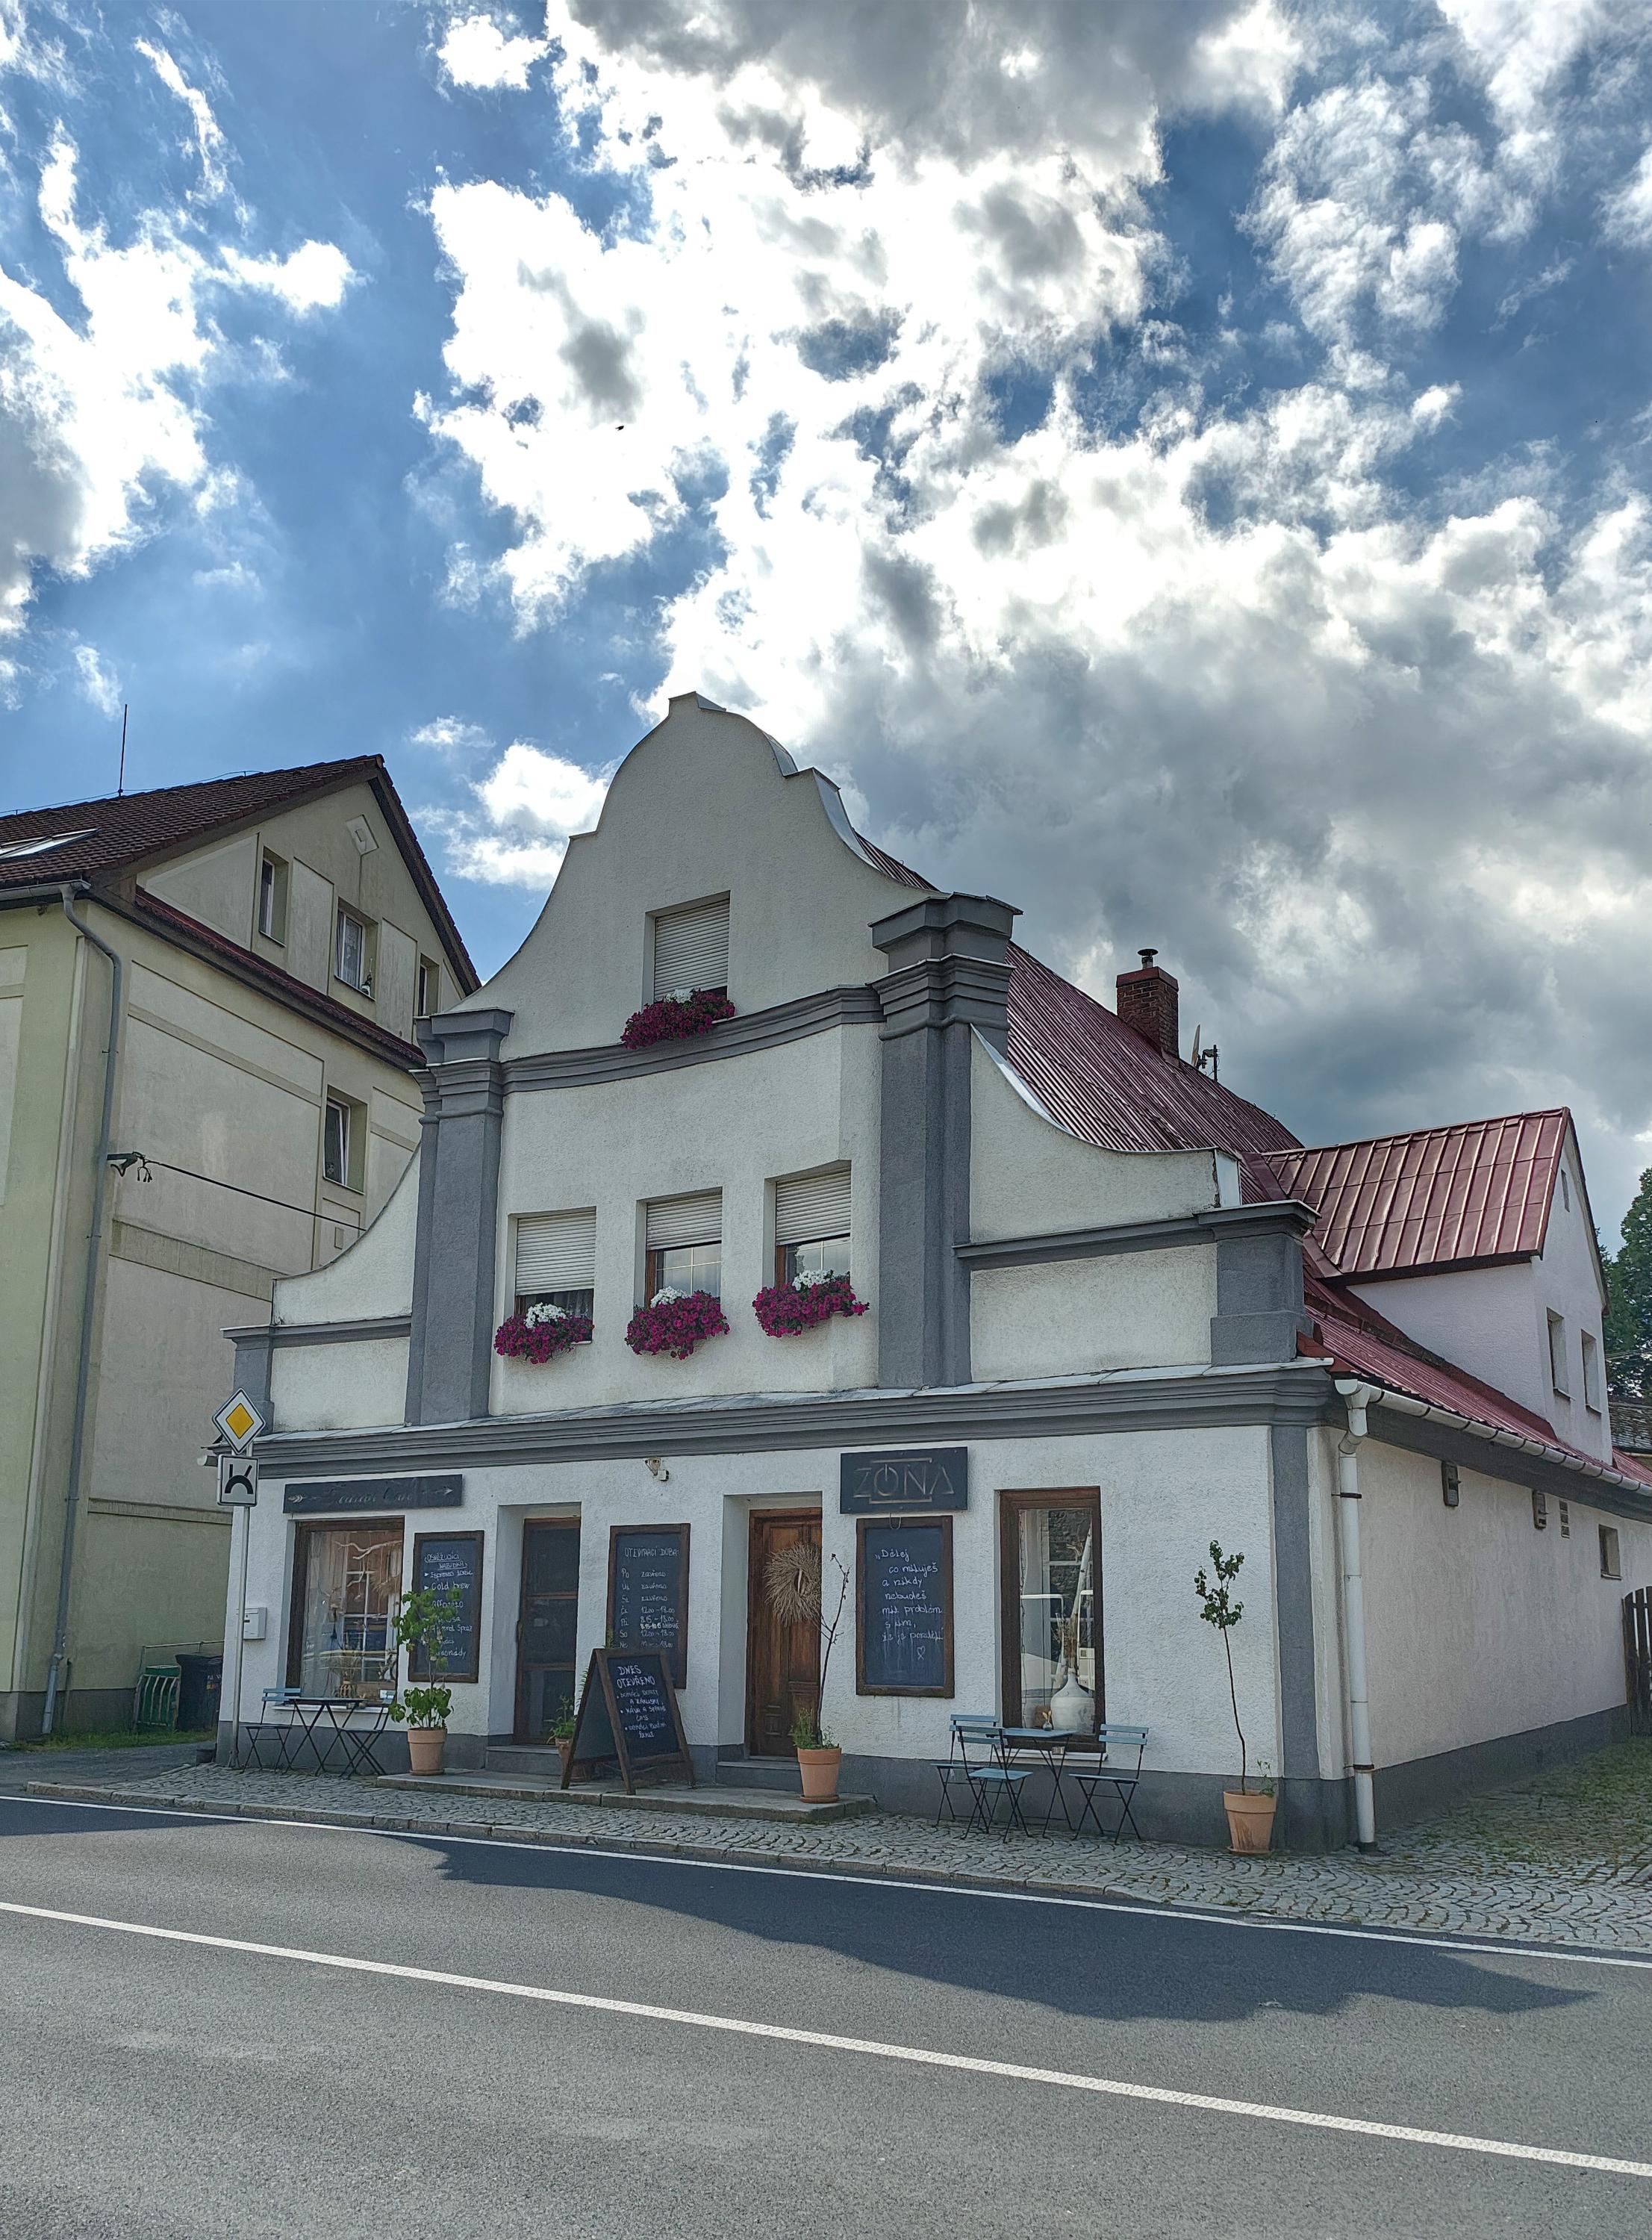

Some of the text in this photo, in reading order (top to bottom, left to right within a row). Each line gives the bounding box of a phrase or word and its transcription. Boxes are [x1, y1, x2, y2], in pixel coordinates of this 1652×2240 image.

[621, 1568, 630, 1578] Po
[888, 1561, 938, 1578] co miluješ
[431, 1581, 449, 1590] Cold
[894, 1576, 923, 1588] nikdy
[885, 1590, 927, 1600] nebudeš
[620, 1629, 628, 1637] So
[897, 1632, 906, 1645] je
[617, 1664, 642, 1676] DNES
[617, 1675, 656, 1689] OTEVŘENO
